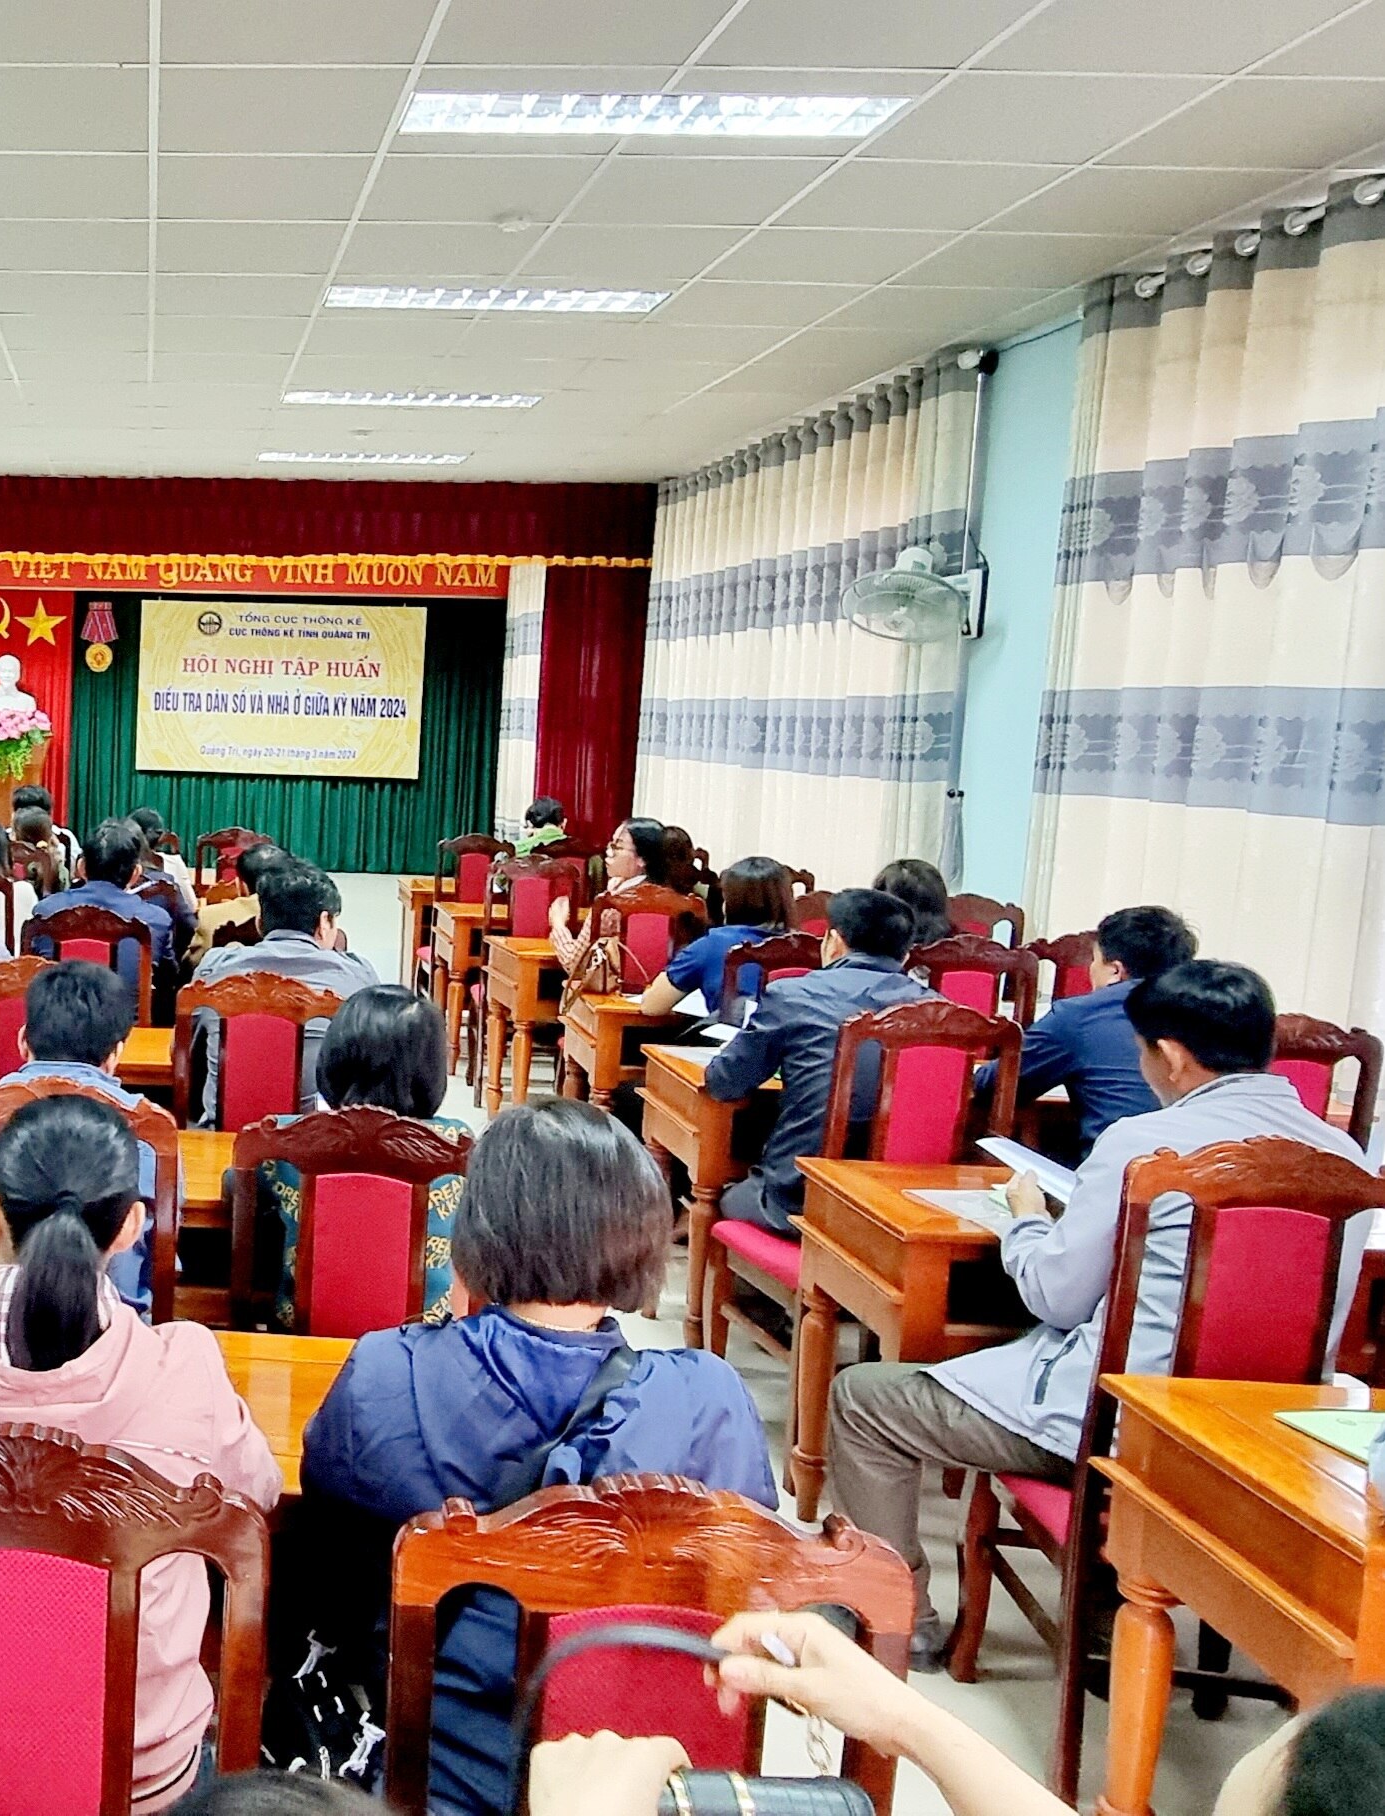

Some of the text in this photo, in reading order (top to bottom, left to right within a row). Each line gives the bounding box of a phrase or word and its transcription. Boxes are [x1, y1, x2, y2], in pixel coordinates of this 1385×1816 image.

[86, 561, 148, 581] NAM
[158, 560, 254, 588] QUANG
[267, 563, 335, 584] VINH
[229, 627, 248, 637] CỤC
[283, 627, 295, 638] KÊ
[356, 630, 370, 642] TRỊ
[182, 653, 381, 679] HỘI NGHỊ TẬP HUẤN
[182, 692, 202, 712] TRA
[206, 689, 229, 713] DÂN
[232, 686, 247, 714] SỐ
[250, 690, 264, 714] VÀ
[267, 691, 290, 715] NHÀ
[293, 688, 302, 715] Ở
[304, 692, 330, 716] GIỮA
[333, 693, 348, 717] KỲ
[350, 693, 376, 717] NĂM
[379, 697, 407, 718] 2024
[336, 748, 357, 760] 2024
